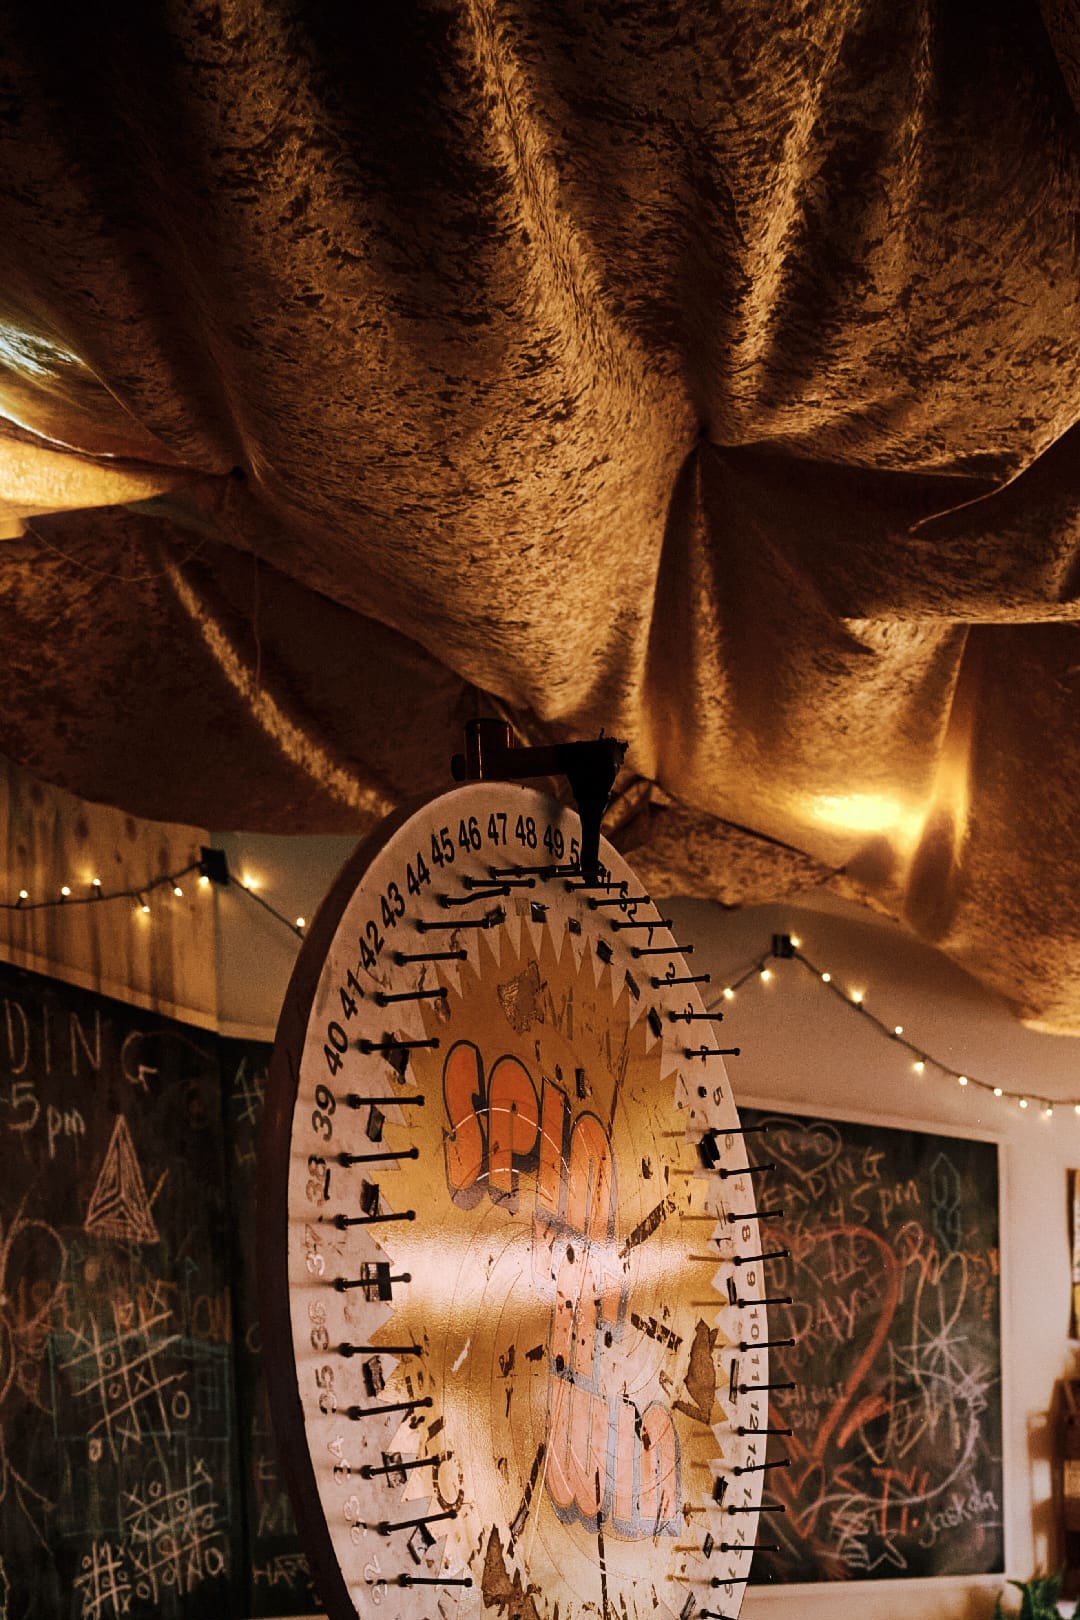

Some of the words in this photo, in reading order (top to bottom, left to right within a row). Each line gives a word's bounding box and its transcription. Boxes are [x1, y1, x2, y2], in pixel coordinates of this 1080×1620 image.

[431, 827, 455, 867] 45
[459, 817, 481, 853] 46
[488, 813, 507, 846] 47
[515, 815, 537, 849] 48
[543, 825, 564, 859] 49
[406, 853, 431, 897] 44
[380, 882, 406, 928] 43
[359, 920, 384, 967] 42
[339, 969, 366, 1020] 41
[324, 1021, 348, 1077] 40
[312, 1084, 336, 1141] 39
[713, 1086, 724, 1107] 5
[442, 1038, 618, 1242] SPIN
[306, 1153, 331, 1202] 38
[305, 1221, 327, 1276] 37
[741, 1225, 751, 1242] 8
[746, 1270, 756, 1287] 9
[308, 1301, 329, 1353] 36
[750, 1308, 760, 1339] 10
[315, 1364, 336, 1415] 35
[751, 1353, 760, 1382] 11
[749, 1401, 760, 1431] 12
[327, 1436, 352, 1484] 34
[544, 1372, 682, 1538] WIN
[343, 1494, 368, 1545] 33
[364, 1555, 388, 1606] 32
